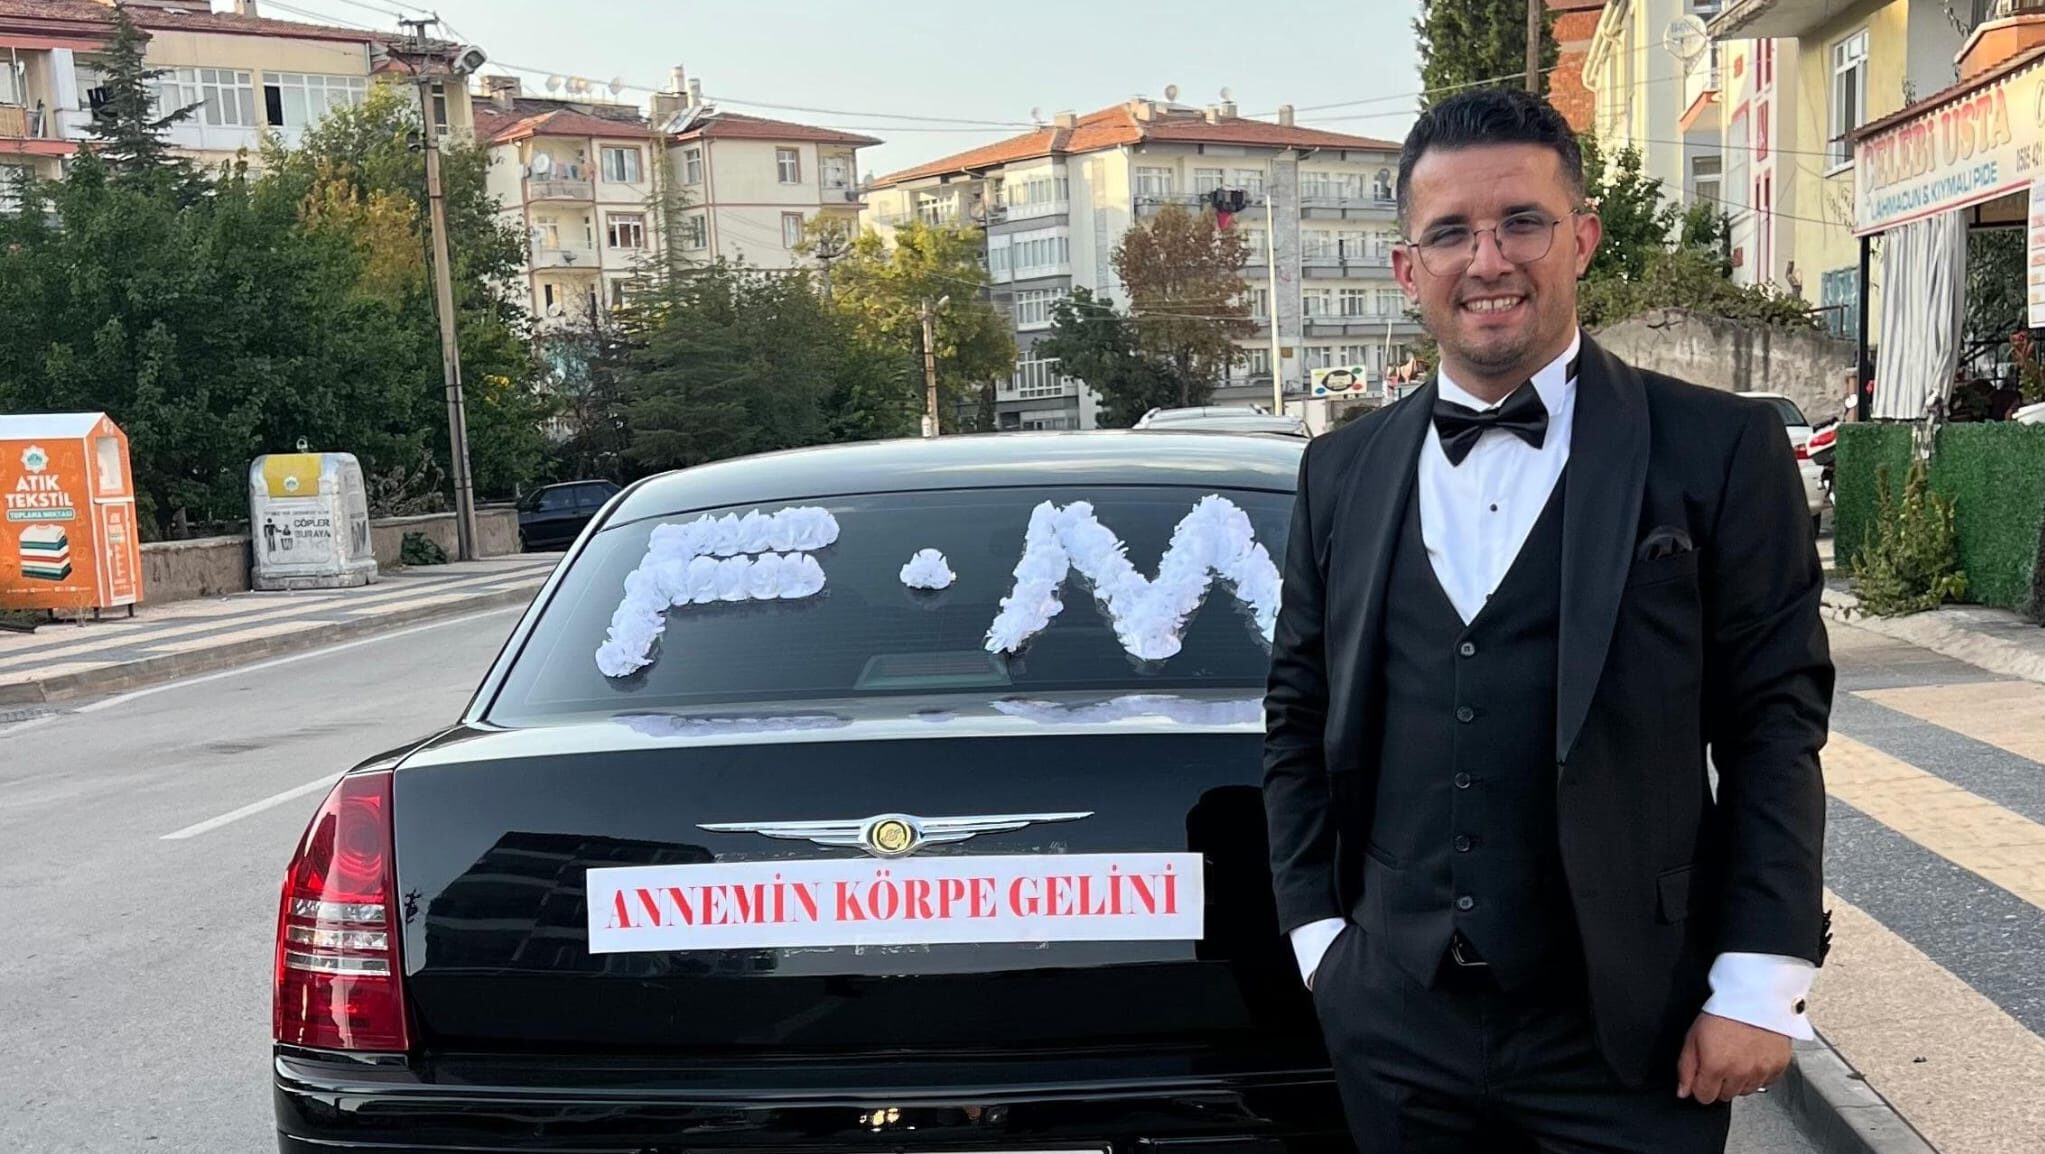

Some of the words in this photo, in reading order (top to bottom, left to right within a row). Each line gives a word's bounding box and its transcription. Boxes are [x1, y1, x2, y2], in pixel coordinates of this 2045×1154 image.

[1941, 87, 2012, 166] USTA
[1871, 188, 1921, 220] LAHMACUN
[16, 474, 60, 492] ATIK
[605, 872, 821, 929] ANNEMİN
[835, 869, 998, 922] KÖRPE
[1008, 863, 1180, 917] GELİNİ
